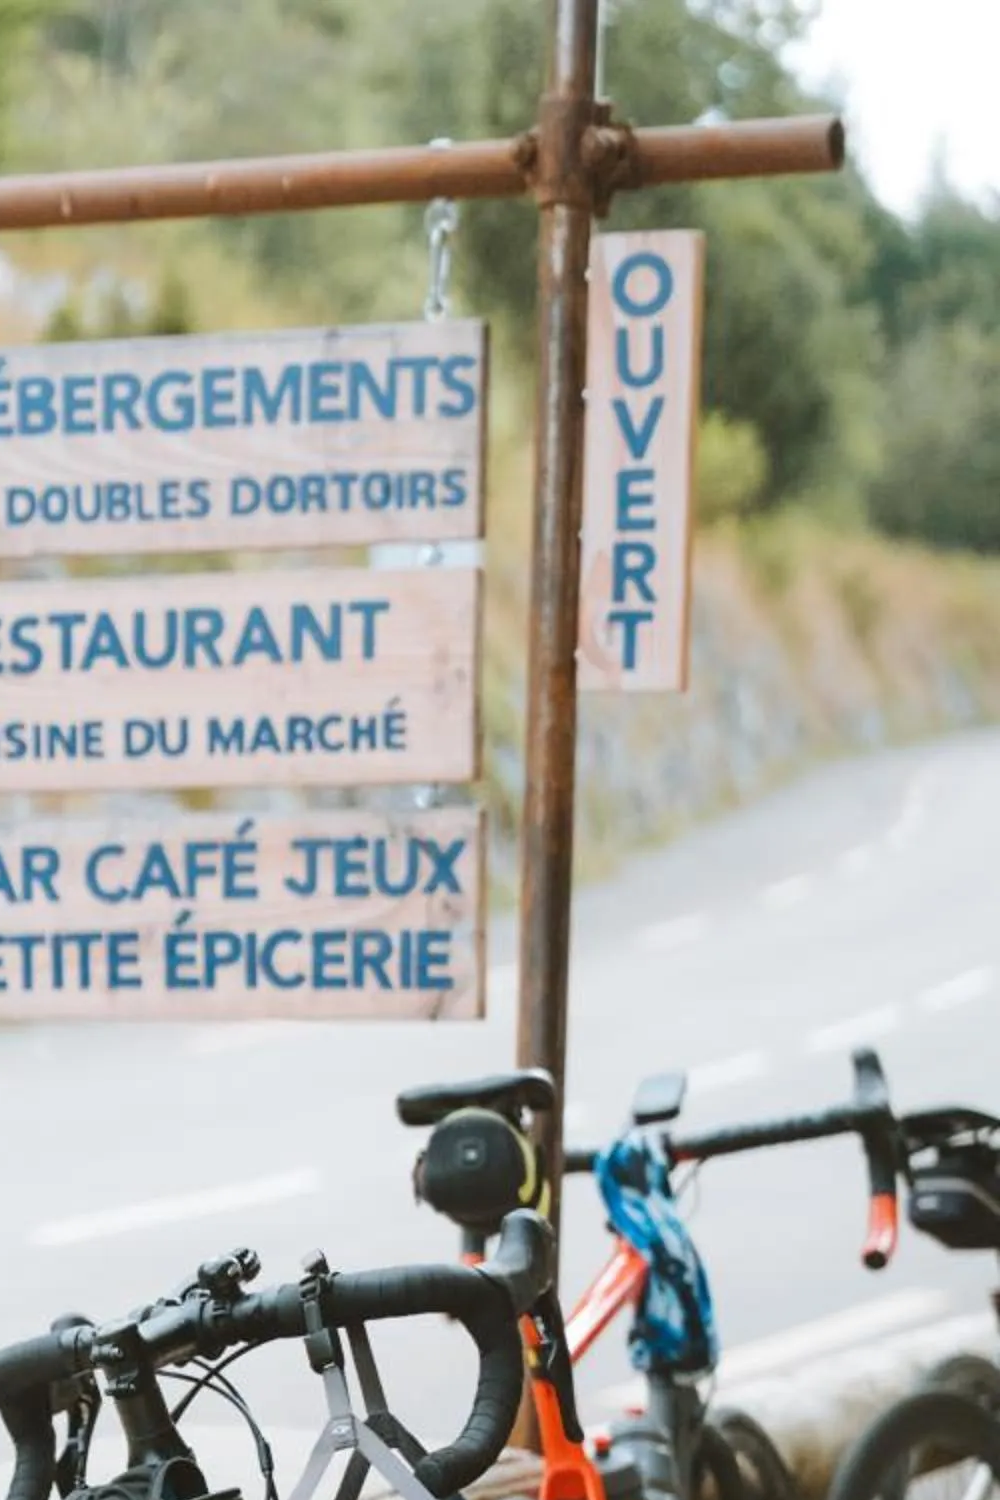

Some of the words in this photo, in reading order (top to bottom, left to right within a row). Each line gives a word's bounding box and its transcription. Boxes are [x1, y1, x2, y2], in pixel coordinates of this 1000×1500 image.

[5, 480, 211, 527] DOUBLES
[230, 469, 468, 517] DORTOIRS
[609, 252, 673, 669] OUVERT
[123, 717, 189, 758] DU
[207, 696, 407, 755] MARCHÉ
[85, 818, 258, 901] CAFÉ
[283, 837, 467, 898] JEUX
[164, 910, 455, 990] ÉPICERIE
